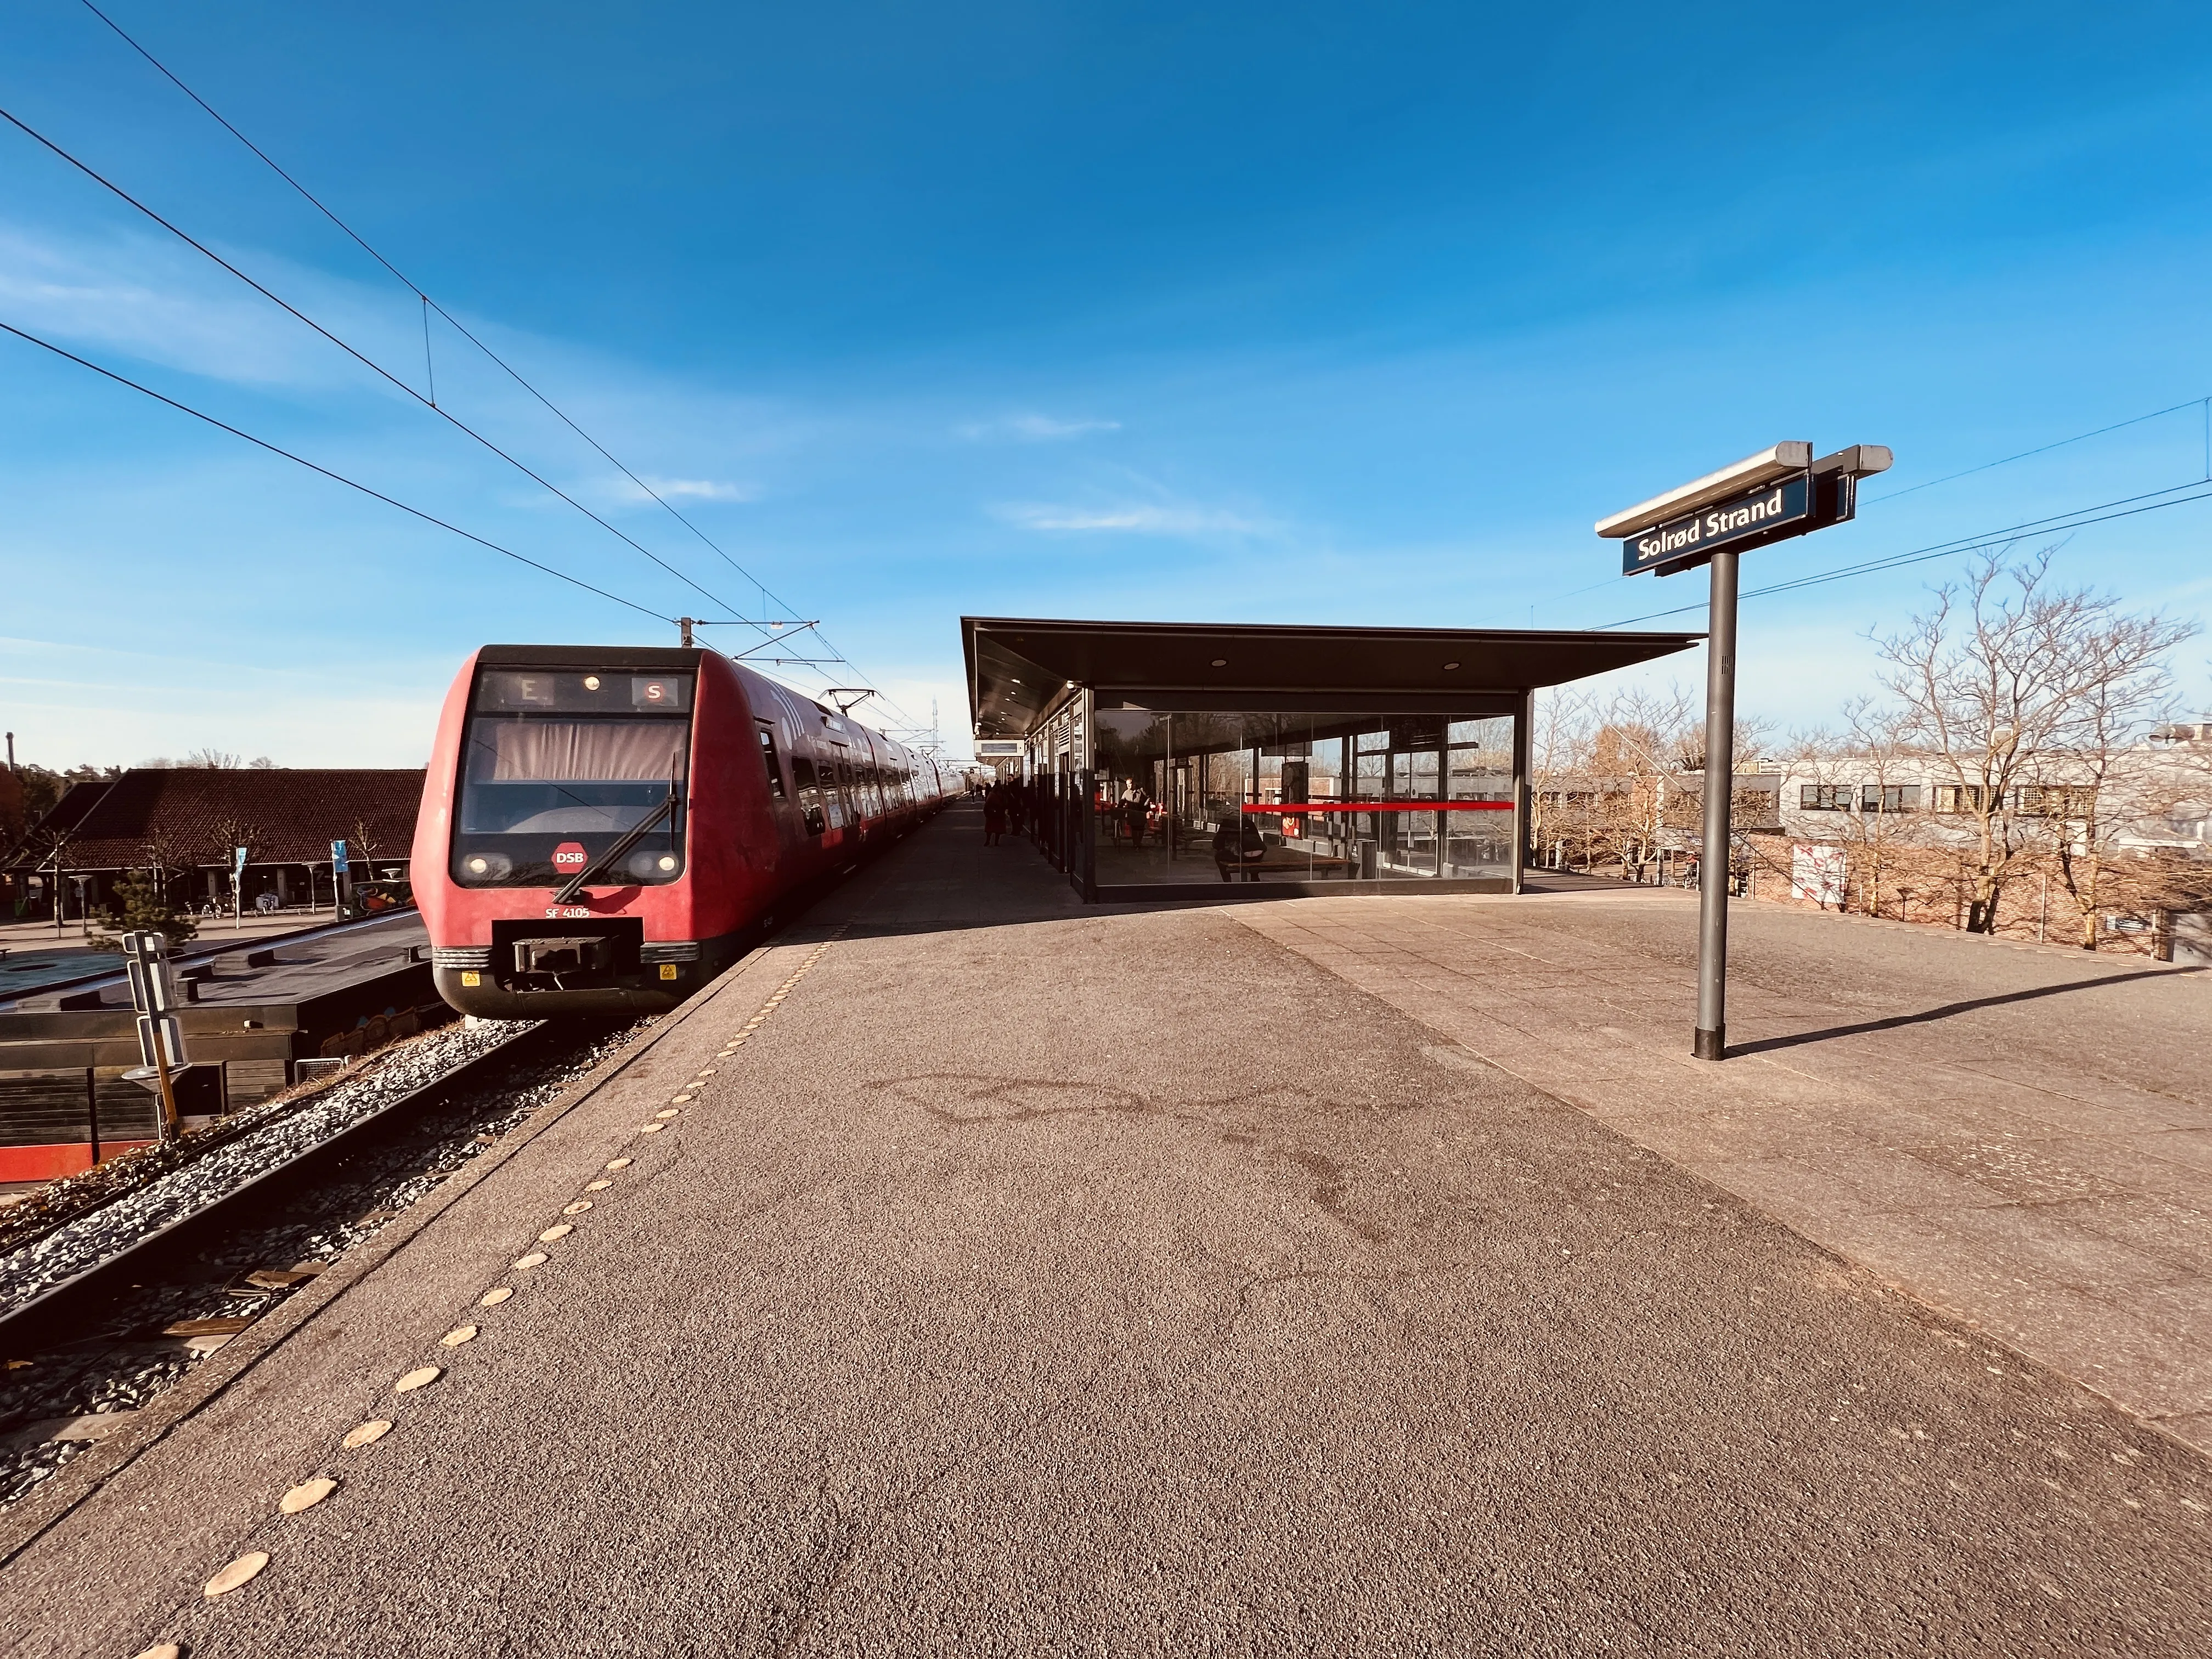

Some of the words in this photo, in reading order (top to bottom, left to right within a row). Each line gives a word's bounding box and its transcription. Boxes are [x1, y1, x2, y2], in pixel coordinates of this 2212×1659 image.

[1638, 519, 1700, 561] Solrød
[1706, 488, 1782, 537] Strand
[647, 685, 661, 699] S
[556, 853, 584, 863] DSB
[545, 908, 560, 918] SF
[562, 907, 590, 918] 4105
